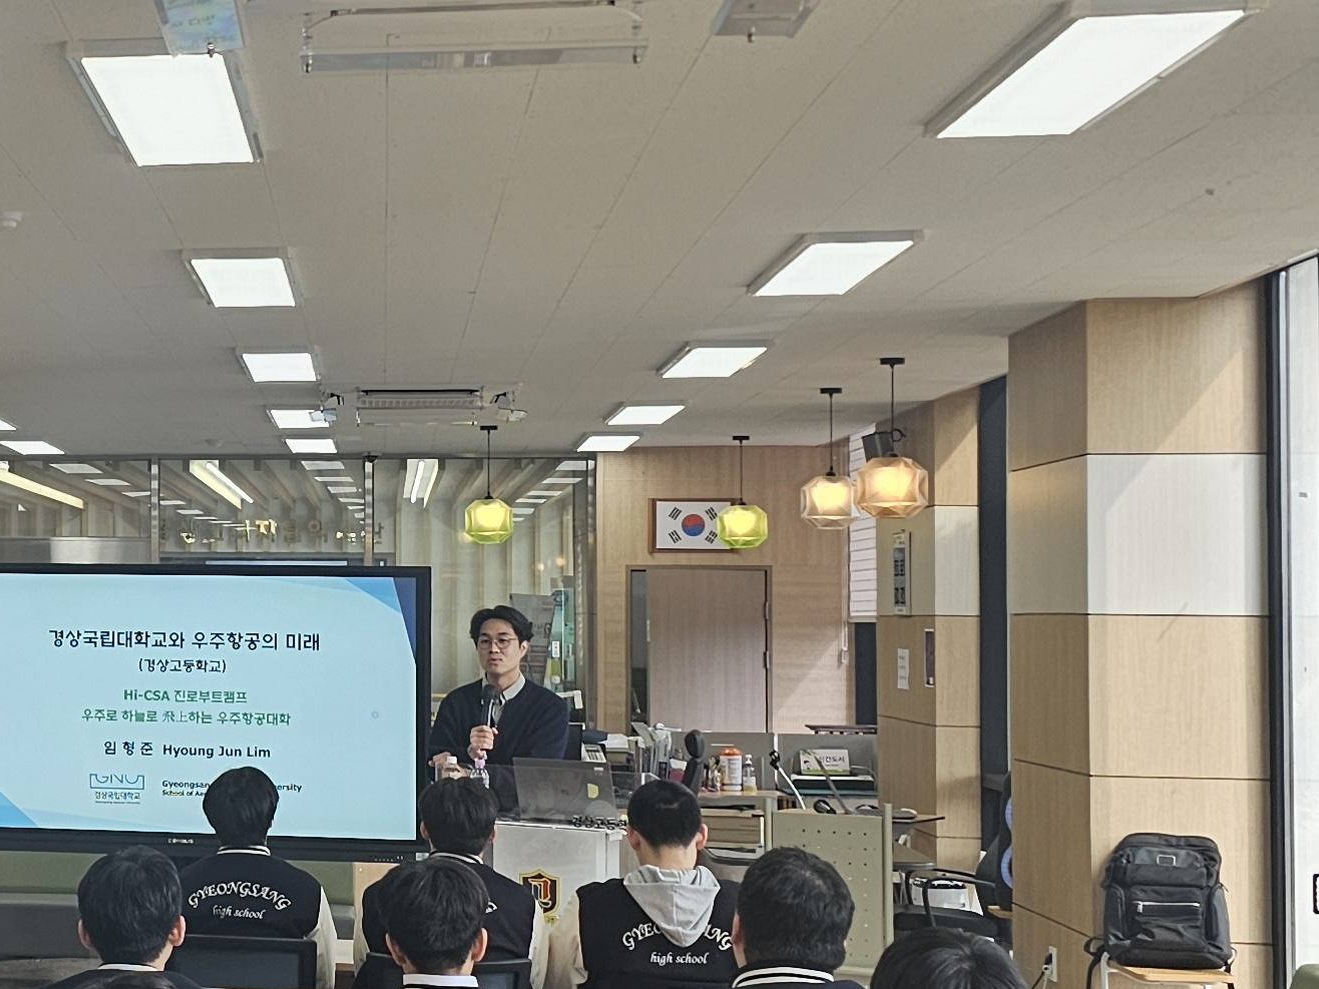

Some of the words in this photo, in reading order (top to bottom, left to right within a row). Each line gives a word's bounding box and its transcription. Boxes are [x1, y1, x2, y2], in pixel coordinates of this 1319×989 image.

[48, 630, 185, 648] 경상국립대학교와
[192, 631, 277, 651] 우주항공의
[286, 633, 320, 651] 미래
[138, 658, 227, 673] (경상고등학교)
[123, 689, 170, 701] Hi-CSA
[174, 689, 248, 703] 진로부트캠프
[82, 708, 118, 722] 우주로
[121, 709, 159, 722] 하늘로
[216, 711, 291, 726] 우주항공대학
[104, 741, 116, 755] 임
[122, 741, 135, 756] 형
[140, 741, 154, 756] 준
[162, 744, 214, 759] Hyoung
[218, 745, 242, 757] Jun
[246, 746, 271, 758] Lim
[161, 780, 210, 789] Gyeongsan
[277, 783, 303, 793] ersity
[572, 815, 627, 831] 경상고등학
[188, 881, 292, 911] GYEONGSANG
[212, 904, 233, 919] high
[234, 907, 267, 920] school
[650, 951, 674, 967] high
[675, 952, 710, 965] school
